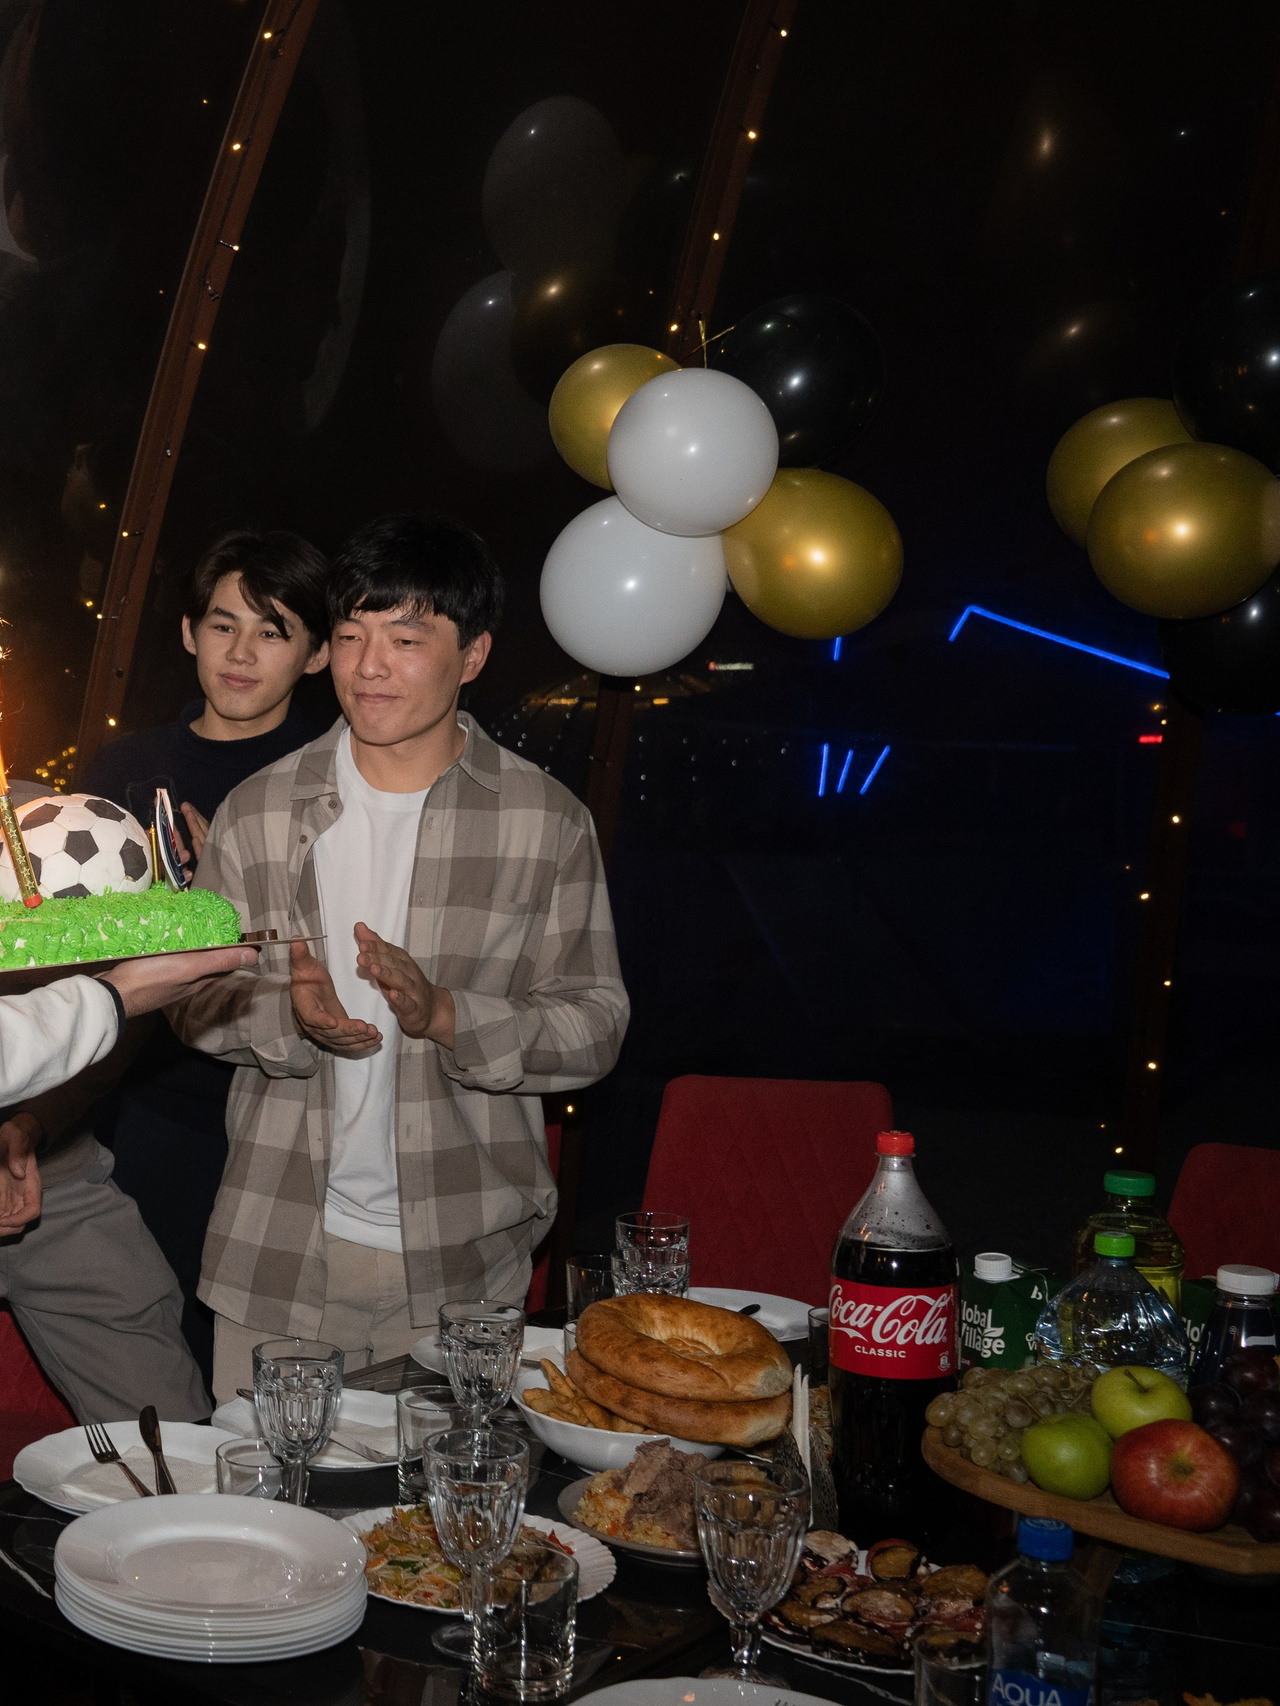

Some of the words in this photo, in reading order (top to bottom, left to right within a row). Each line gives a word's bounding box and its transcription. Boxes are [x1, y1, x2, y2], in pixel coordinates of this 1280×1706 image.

[829, 1284, 954, 1345] Coca-Cola
[961, 1299, 992, 1329] lobal
[854, 1345, 907, 1359] CLASSIC
[991, 1672, 1064, 1706] AQUA
